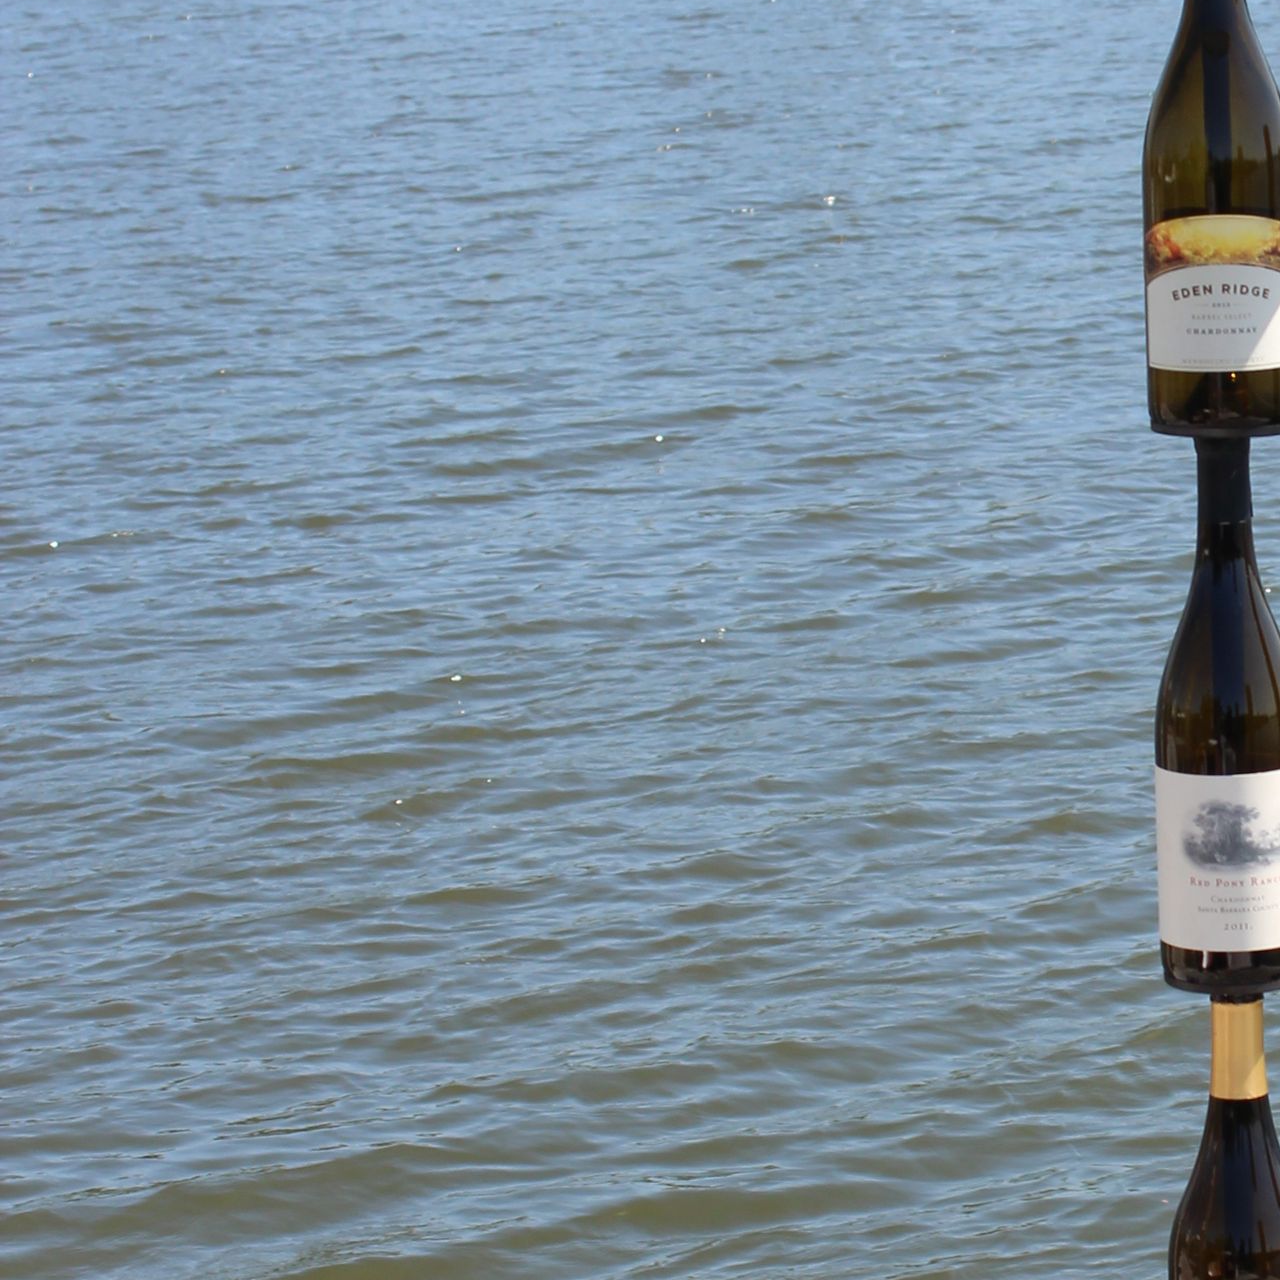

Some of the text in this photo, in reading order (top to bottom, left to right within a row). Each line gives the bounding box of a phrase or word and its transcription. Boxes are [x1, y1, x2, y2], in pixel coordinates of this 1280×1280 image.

[1171, 283, 1271, 301] EDEN RIDGE
[1186, 327, 1258, 335] CHARDONNAY
